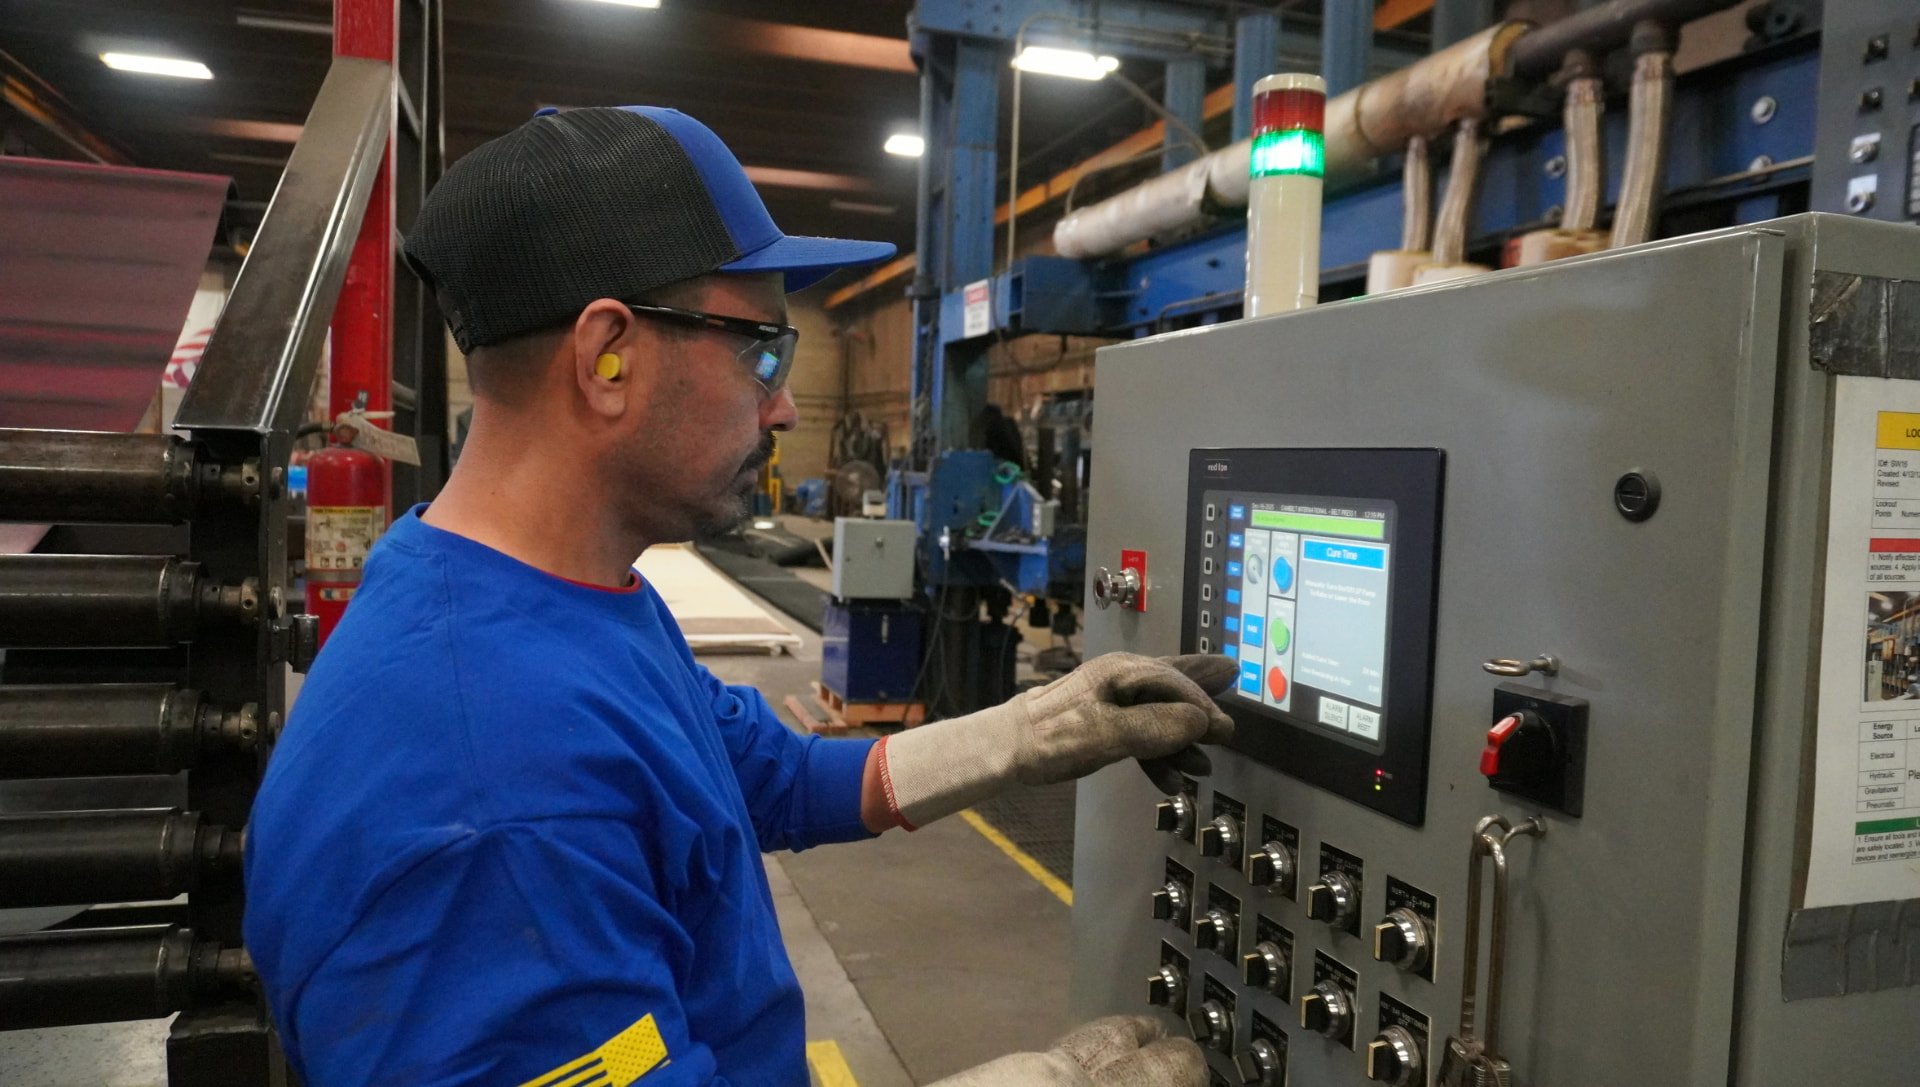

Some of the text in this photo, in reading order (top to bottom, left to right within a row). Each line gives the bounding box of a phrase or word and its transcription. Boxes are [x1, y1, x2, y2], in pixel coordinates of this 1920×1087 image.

[1327, 547, 1358, 560] Cure Time
[1878, 554, 1893, 562] Notify
[1326, 702, 1343, 714] ALARM
[1356, 712, 1374, 724] ALARM
[1873, 723, 1893, 731] Energy
[1870, 752, 1895, 760] Electrical
[1869, 771, 1895, 781] Hydraulic
[1864, 786, 1898, 795] Gravitational
[1866, 801, 1895, 809] Pneumatic
[1864, 835, 1884, 843] Ensure
[1892, 832, 1905, 840] tools
[1907, 831, 1917, 839] and
[1867, 844, 1883, 853] safely
[1877, 852, 1889, 860] and
